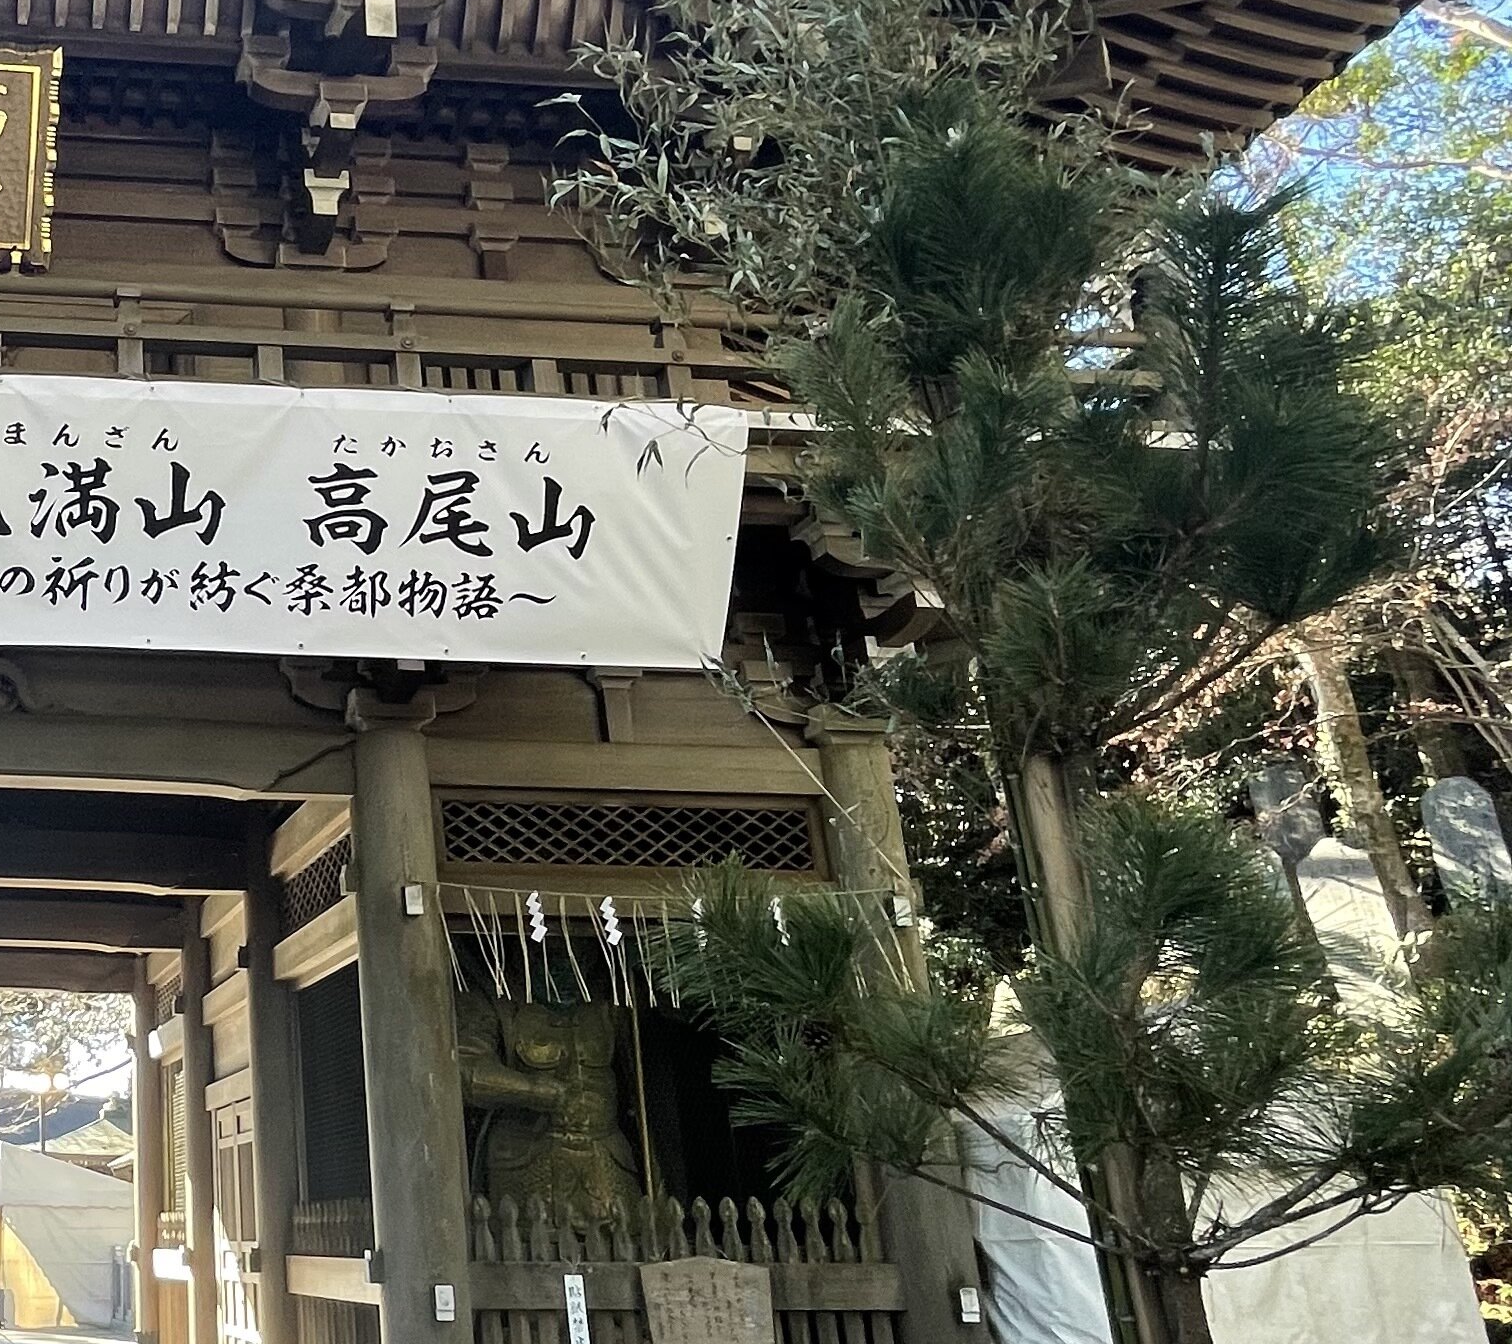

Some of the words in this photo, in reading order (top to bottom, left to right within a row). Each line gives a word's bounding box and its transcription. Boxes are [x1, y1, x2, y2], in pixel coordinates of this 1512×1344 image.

[332, 434, 552, 464] たかおさん
[302, 462, 597, 560] 高尾山
